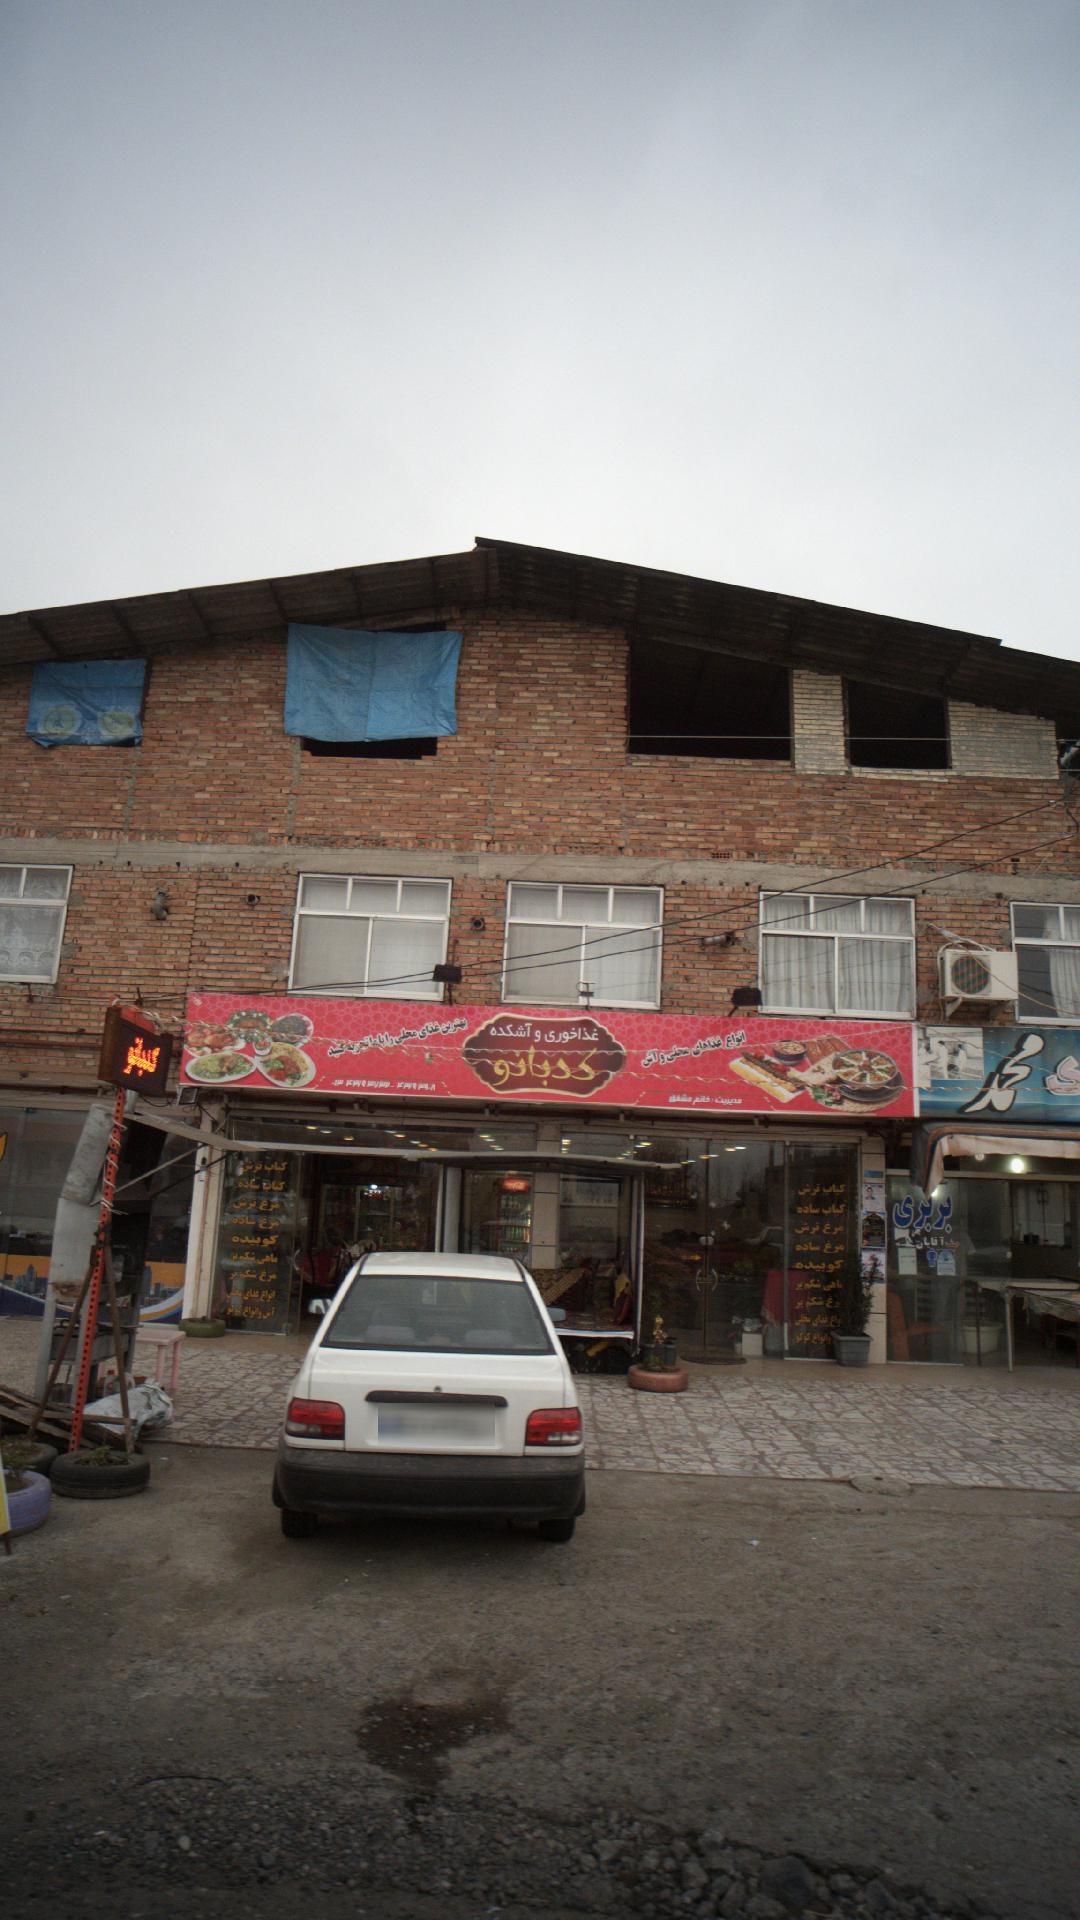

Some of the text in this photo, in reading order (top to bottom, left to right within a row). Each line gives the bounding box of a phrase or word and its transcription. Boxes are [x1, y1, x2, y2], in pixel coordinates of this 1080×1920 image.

[418, 1023, 440, 1039] غذای
[440, 1018, 468, 1034] بهترین
[489, 1023, 600, 1043] غذاخوری و آشکده
[377, 1033, 385, 1046] با
[385, 1032, 394, 1046] را
[393, 1028, 417, 1044] محلی
[725, 1029, 746, 1048] انواع
[327, 1042, 346, 1057] کنید
[346, 1037, 368, 1053] تجربه
[692, 1035, 723, 1057] غذاهای
[641, 1049, 657, 1069] آش
[667, 1044, 690, 1063] محلی
[493, 1045, 597, 1086] کدبانو
[692, 1095, 711, 1106] خانم
[715, 1096, 743, 1106] مدیریت
[264, 1160, 288, 1173] کباب
[822, 1184, 846, 1195] کباب
[892, 1194, 953, 1234] بربری
[231, 1235, 279, 1247] کوبیده
[795, 1260, 844, 1273] کوبیده
